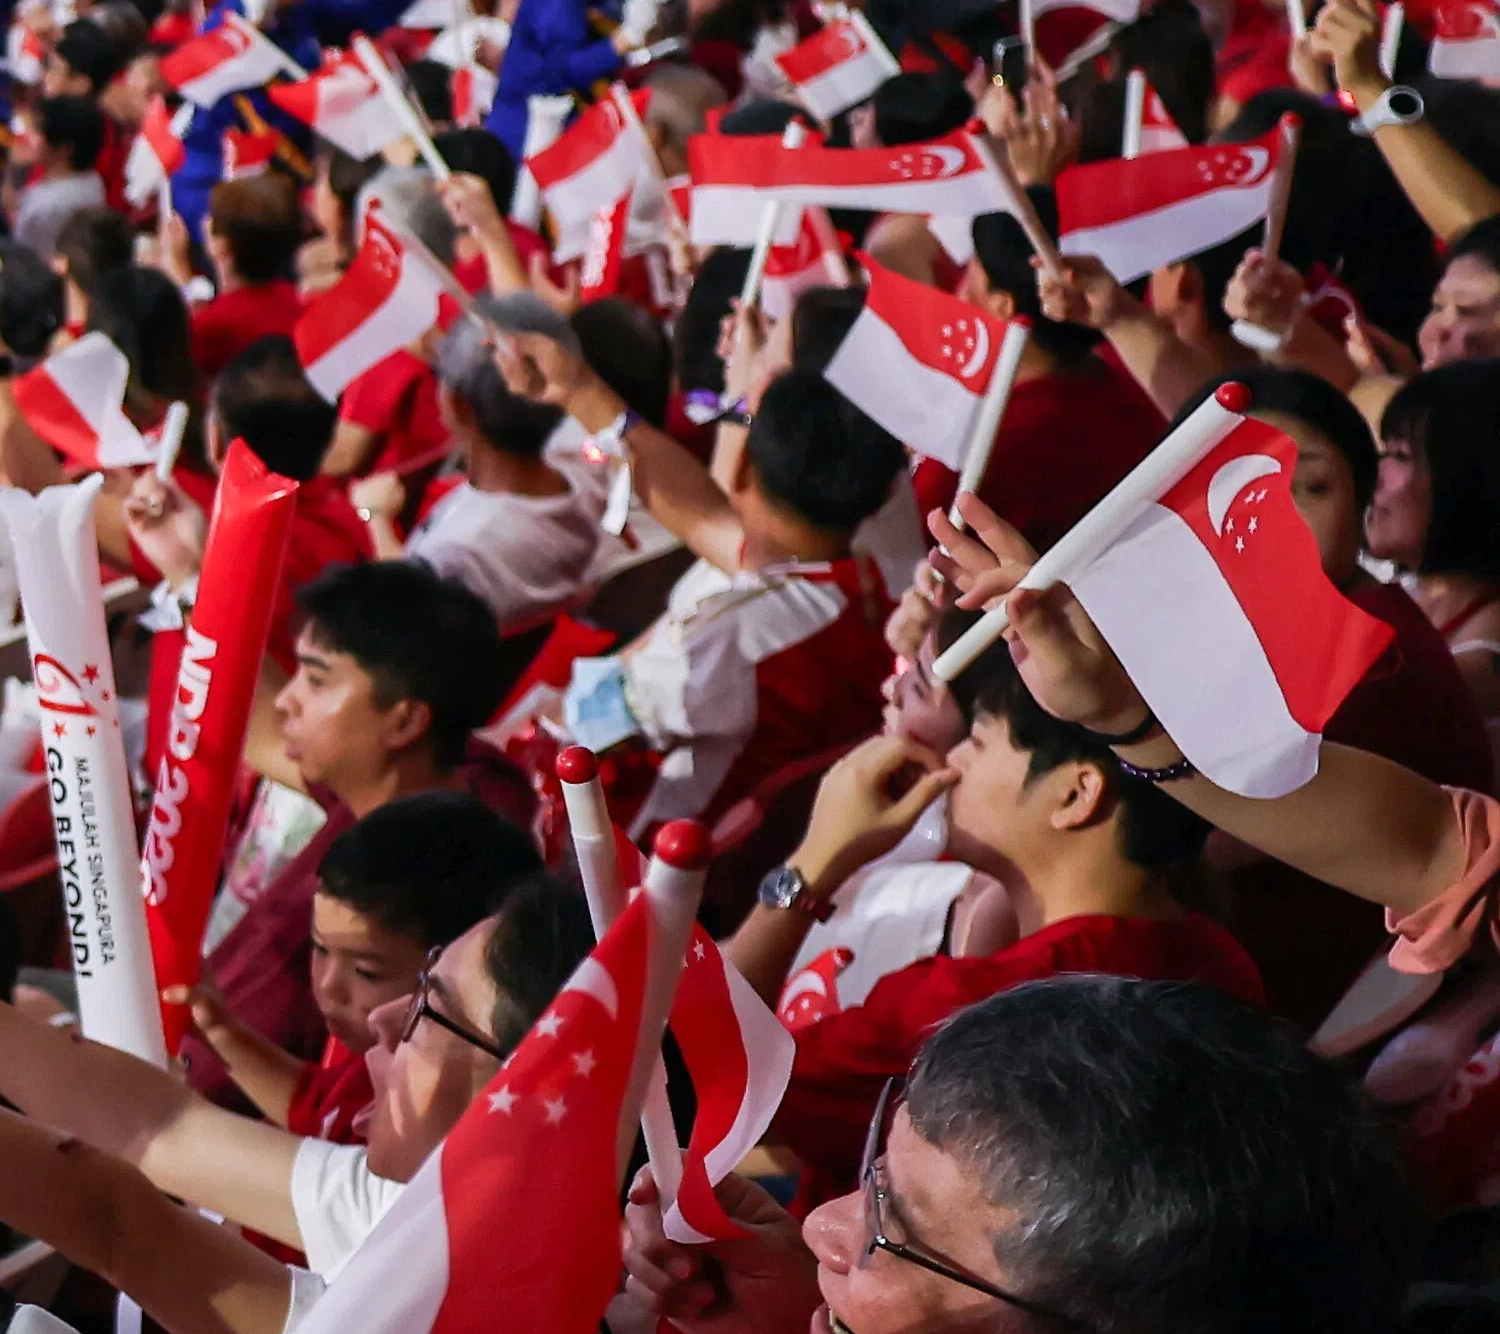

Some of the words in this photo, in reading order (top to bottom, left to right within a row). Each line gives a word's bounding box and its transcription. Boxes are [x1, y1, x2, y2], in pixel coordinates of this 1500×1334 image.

[169, 623, 218, 761] NDP
[47, 746, 68, 806] GO
[55, 816, 93, 980] BEYOND!
[74, 756, 97, 849] MAJULAH
[86, 853, 117, 965] SINGAPURA
